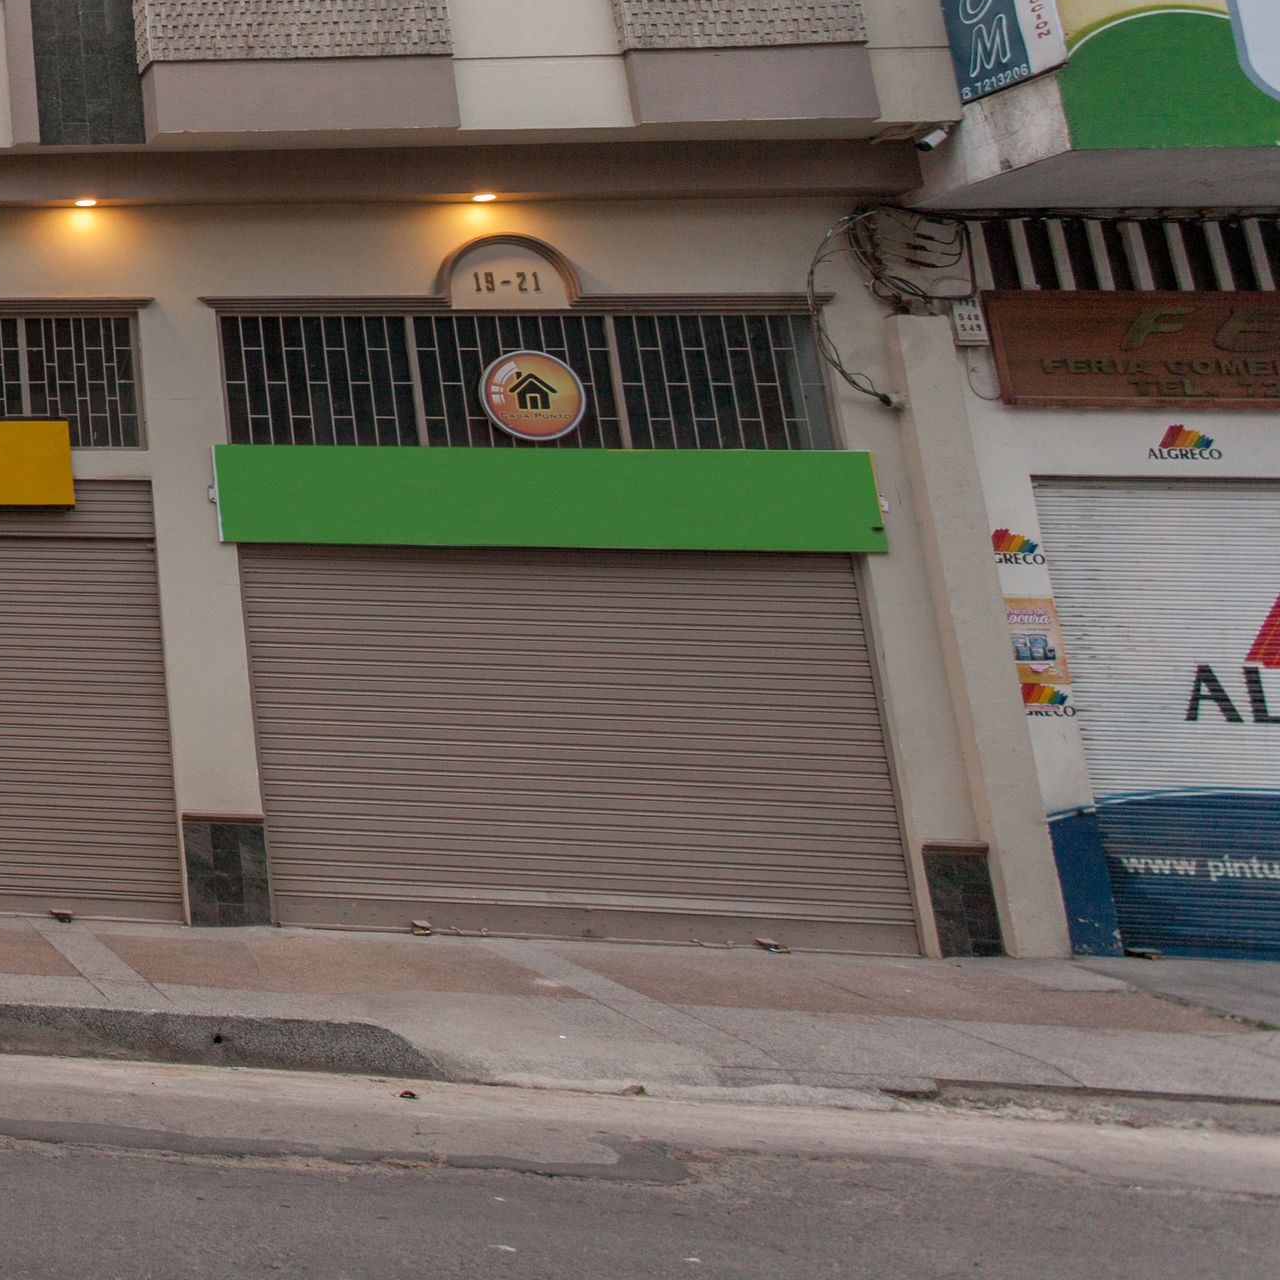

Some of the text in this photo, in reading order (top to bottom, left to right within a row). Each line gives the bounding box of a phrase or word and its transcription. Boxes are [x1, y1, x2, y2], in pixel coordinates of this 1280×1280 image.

[974, 63, 1028, 94] 7213206
[473, 271, 541, 291] 19-21
[1148, 448, 1222, 460] ALGRECO
[1184, 664, 1280, 723] AL
